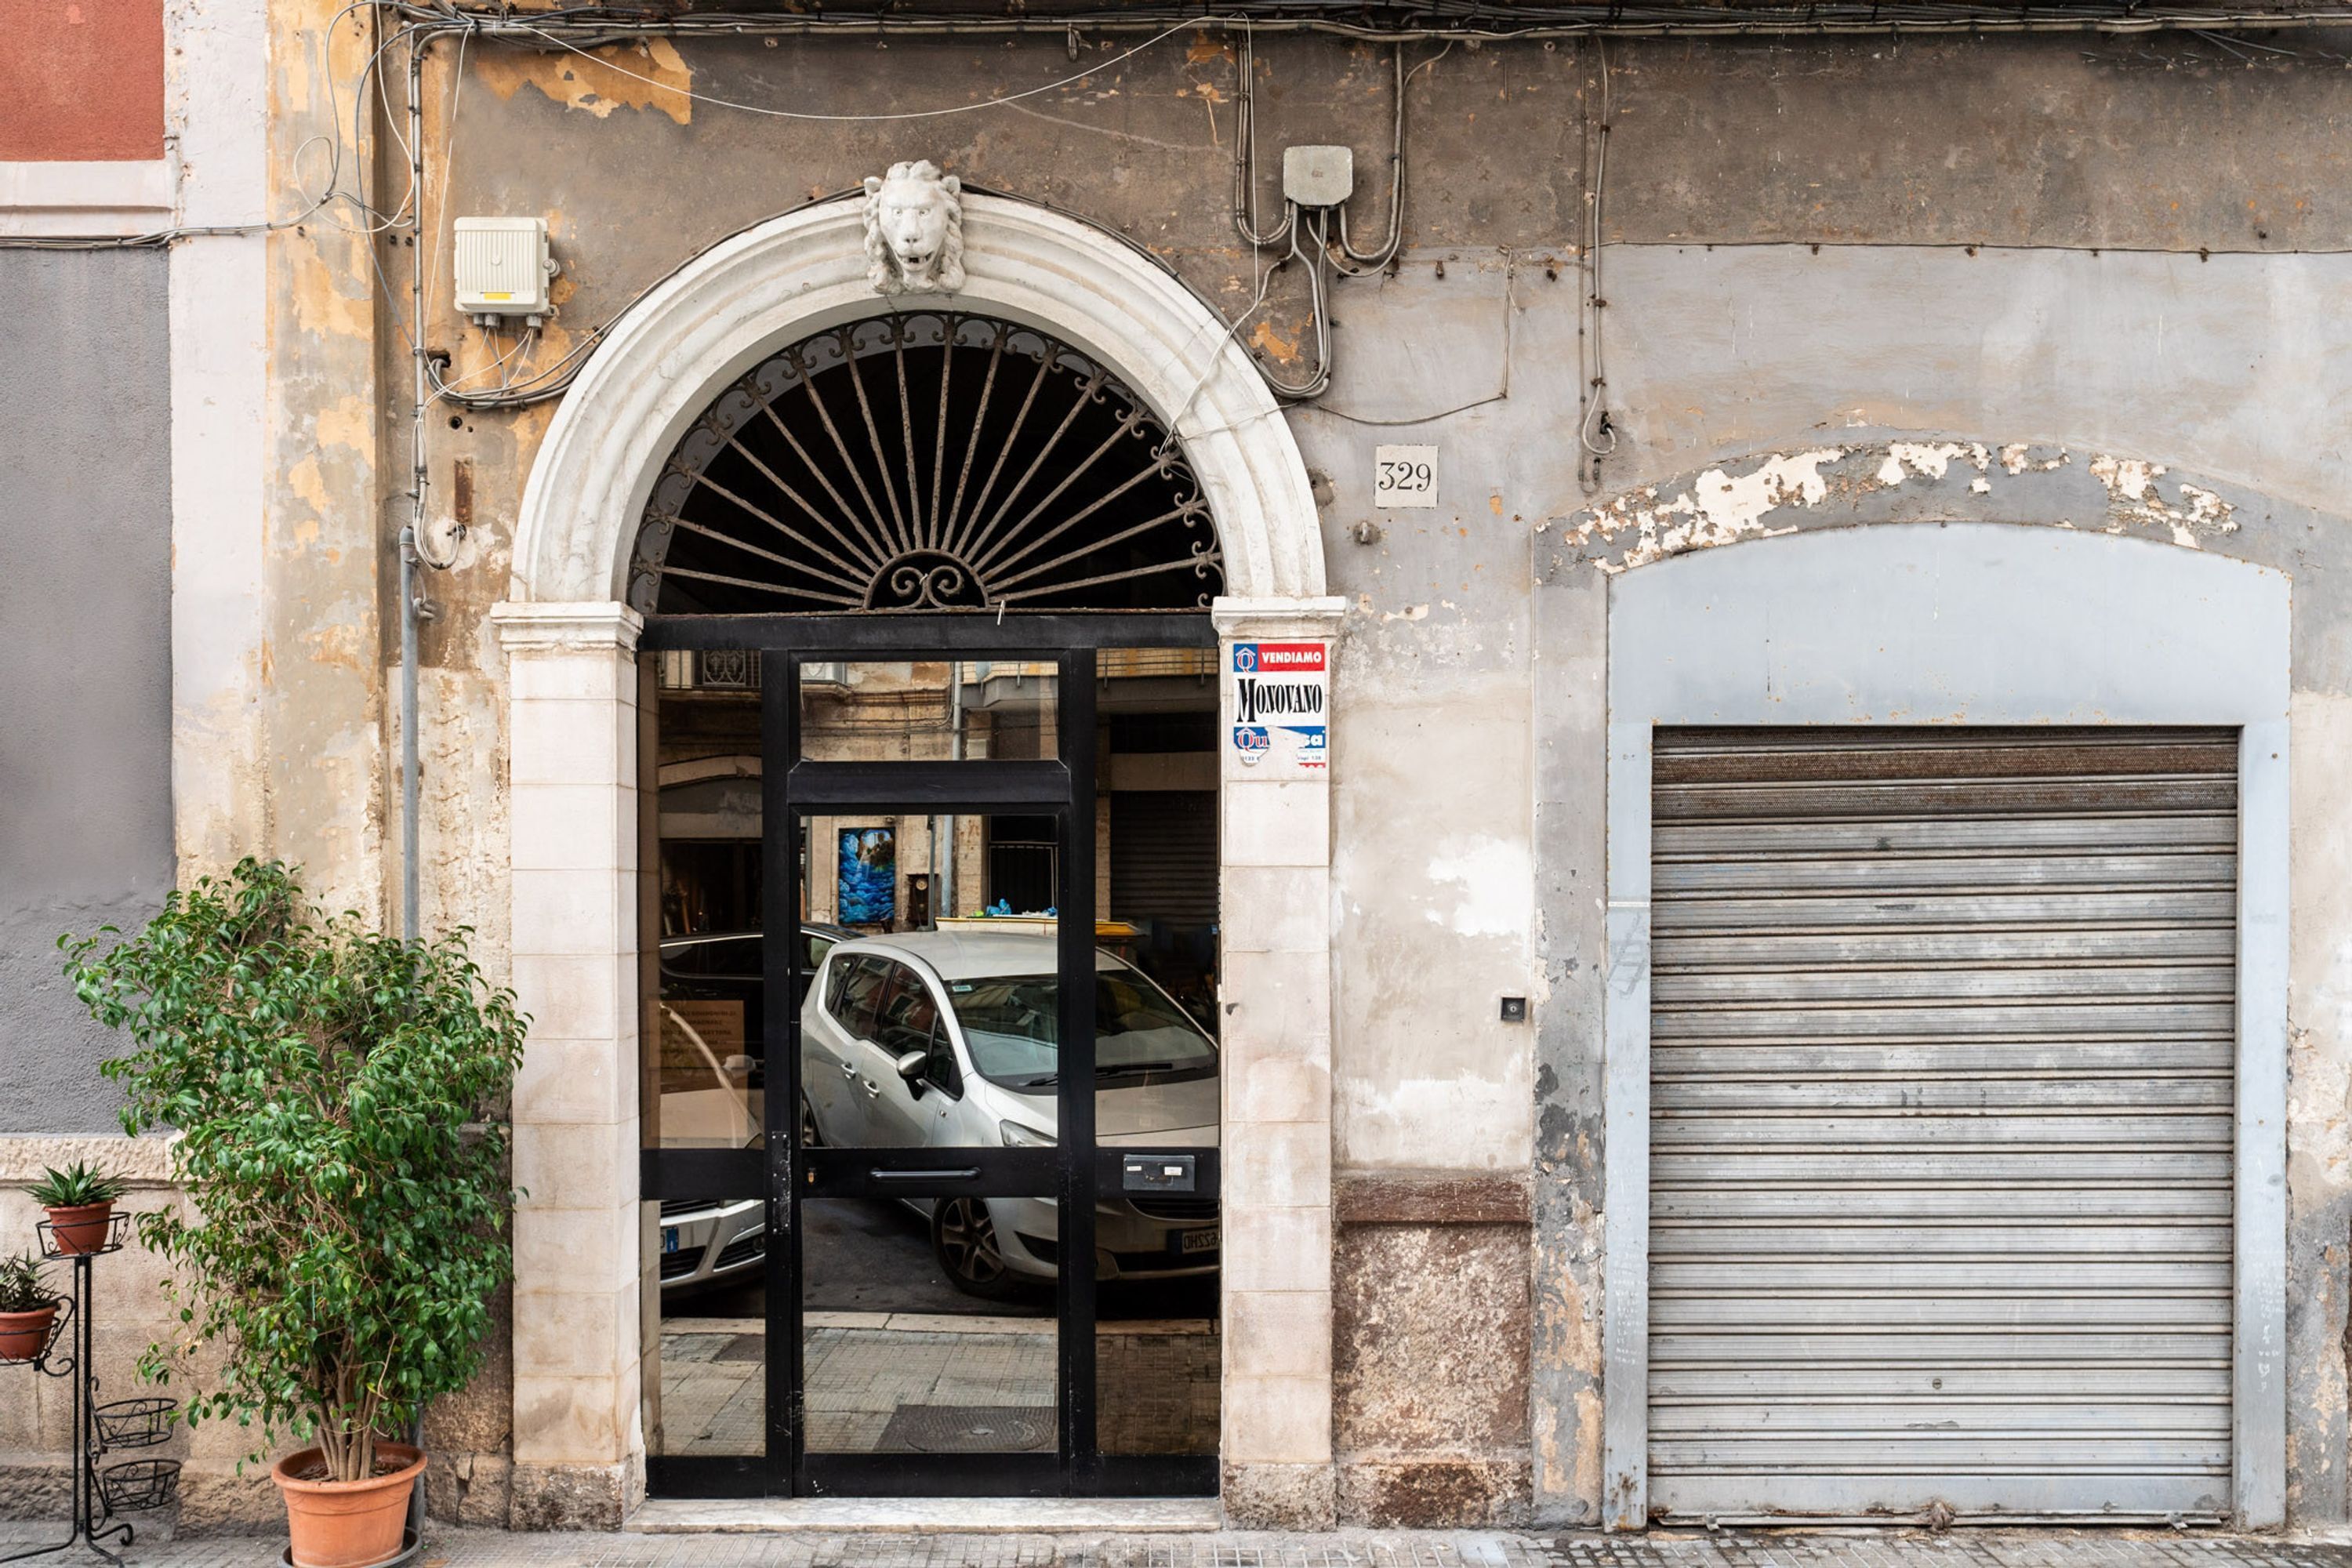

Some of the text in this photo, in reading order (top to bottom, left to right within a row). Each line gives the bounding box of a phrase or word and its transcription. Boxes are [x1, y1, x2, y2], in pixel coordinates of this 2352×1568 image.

[1379, 461, 1431, 492] 329
[1261, 652, 1322, 663] VENDIAMO
[1236, 728, 1268, 752] Qu
